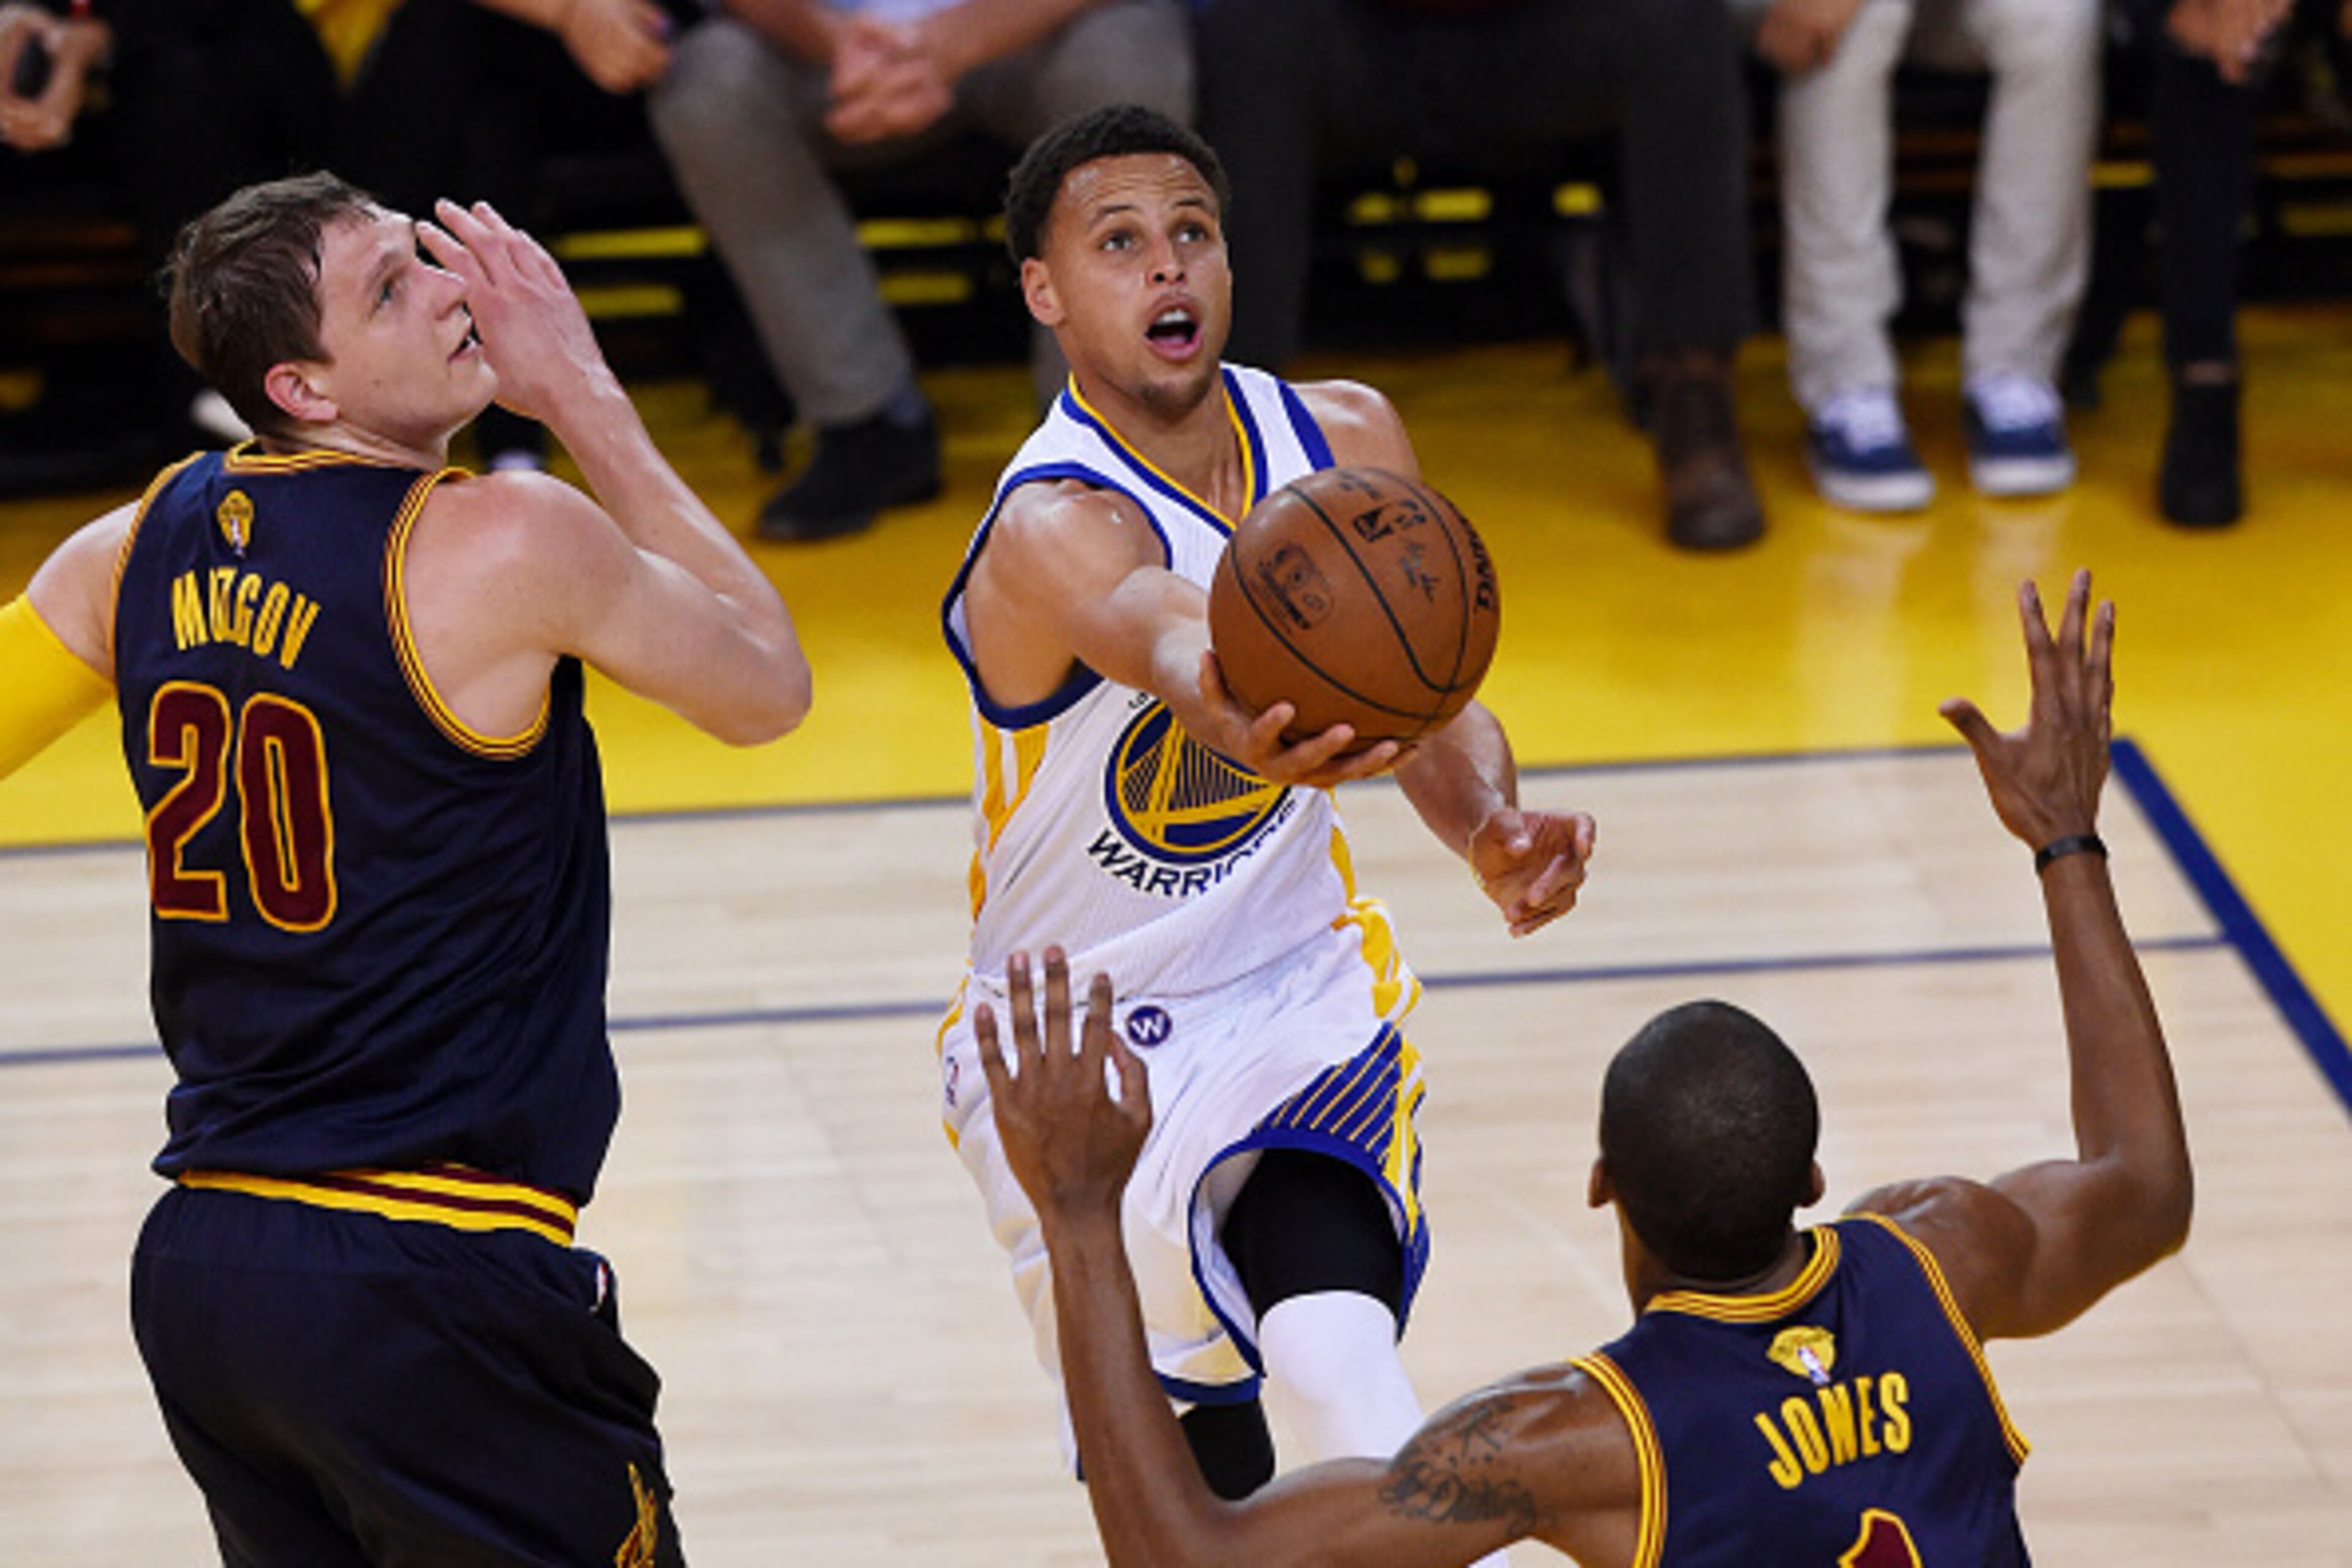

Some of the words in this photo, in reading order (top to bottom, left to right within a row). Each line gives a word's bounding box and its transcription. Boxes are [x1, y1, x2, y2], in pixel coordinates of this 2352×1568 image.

[145, 680, 337, 932] 20
[1131, 1013, 1164, 1041] W
[1754, 1370, 1912, 1489] JONES
